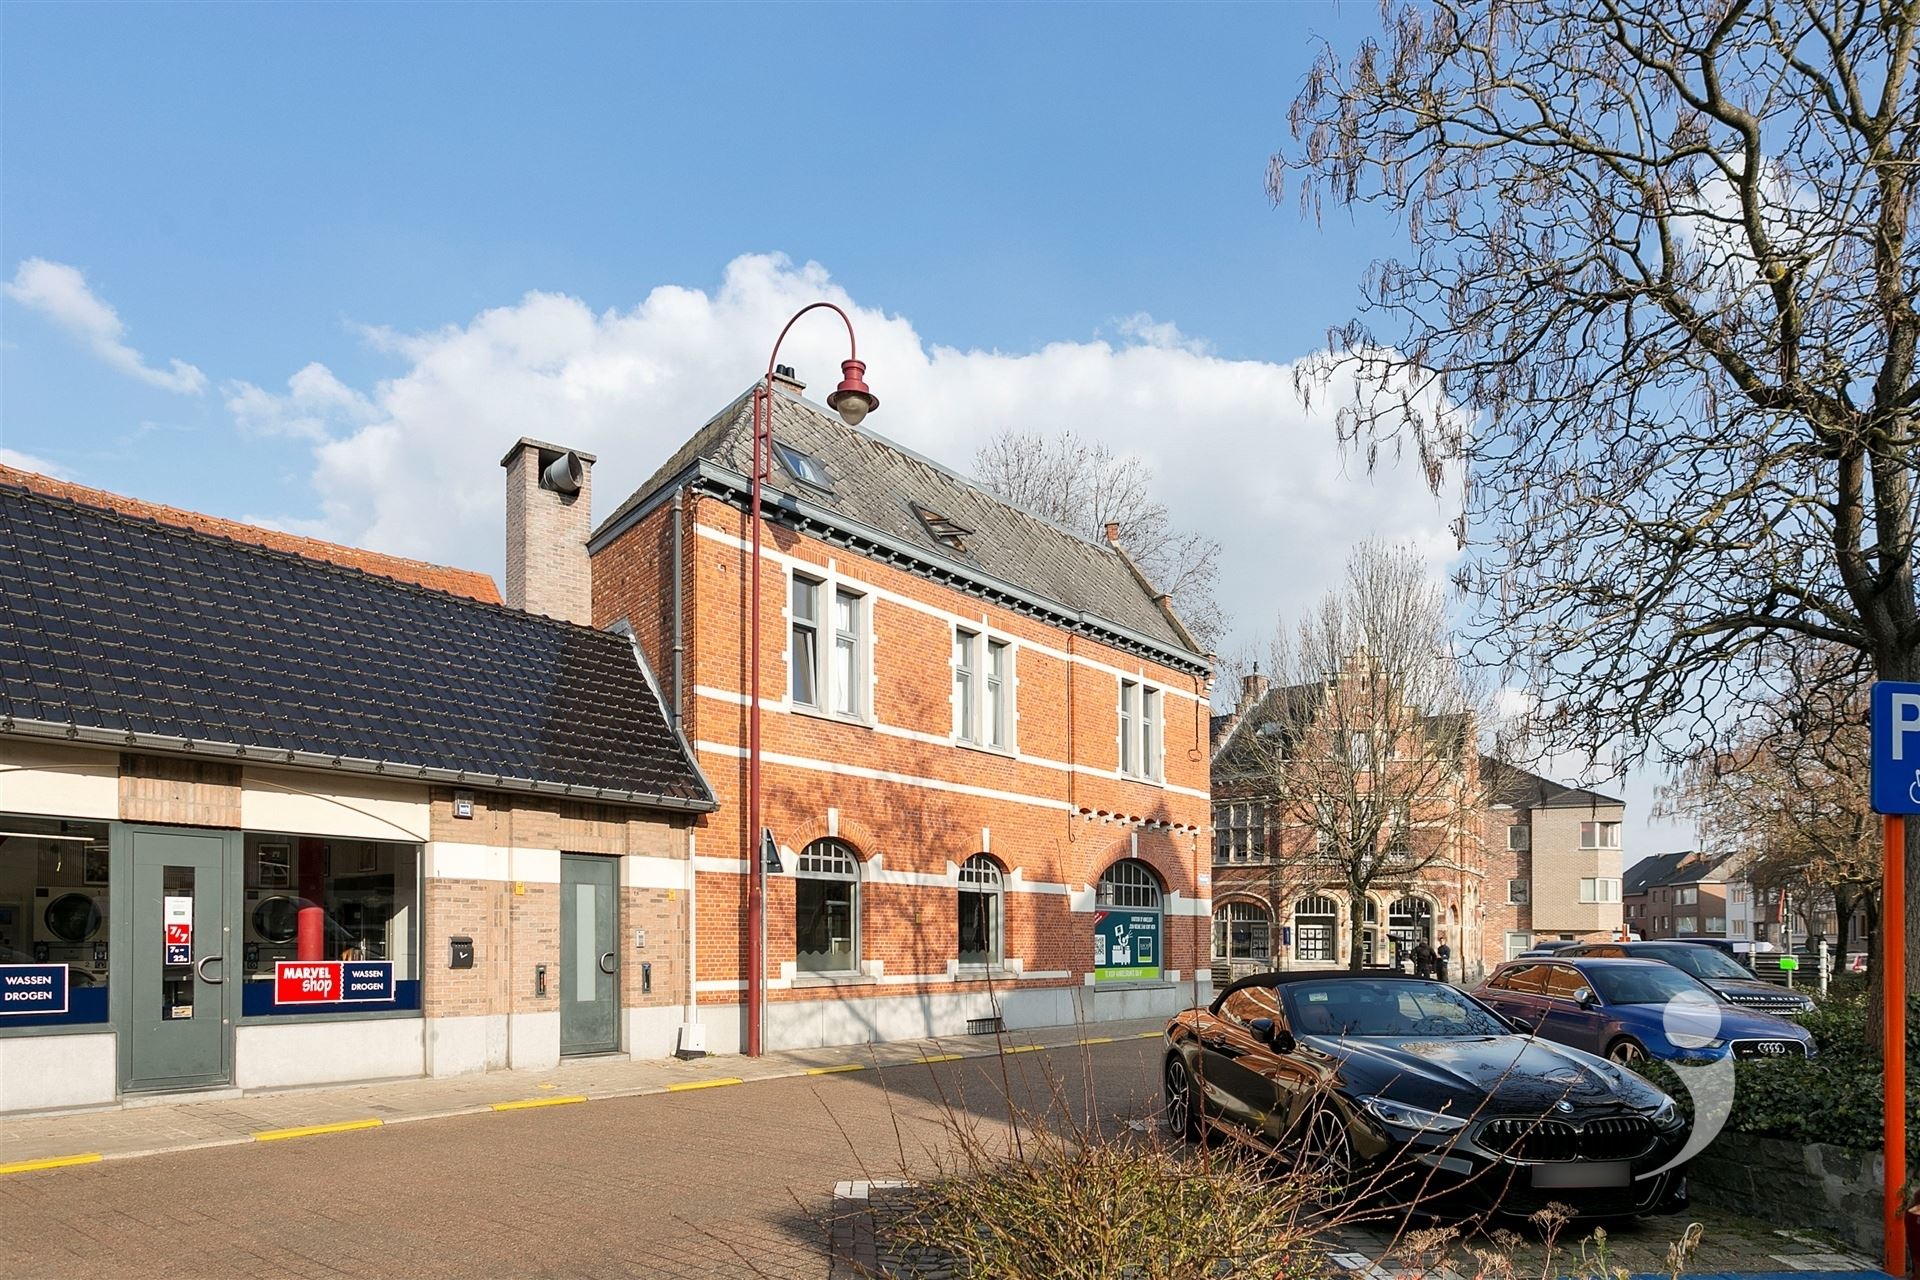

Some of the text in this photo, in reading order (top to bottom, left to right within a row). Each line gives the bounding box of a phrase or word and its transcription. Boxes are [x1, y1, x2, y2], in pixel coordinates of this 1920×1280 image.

[1892, 693, 1920, 760] P
[169, 926, 188, 942] 7/7
[283, 967, 331, 979] MARVEL
[352, 970, 384, 978] WASSEN
[5, 976, 52, 985] WASSEN
[302, 976, 333, 998] shop
[351, 983, 384, 991] DROGEN
[4, 991, 52, 1001] DROGEN
